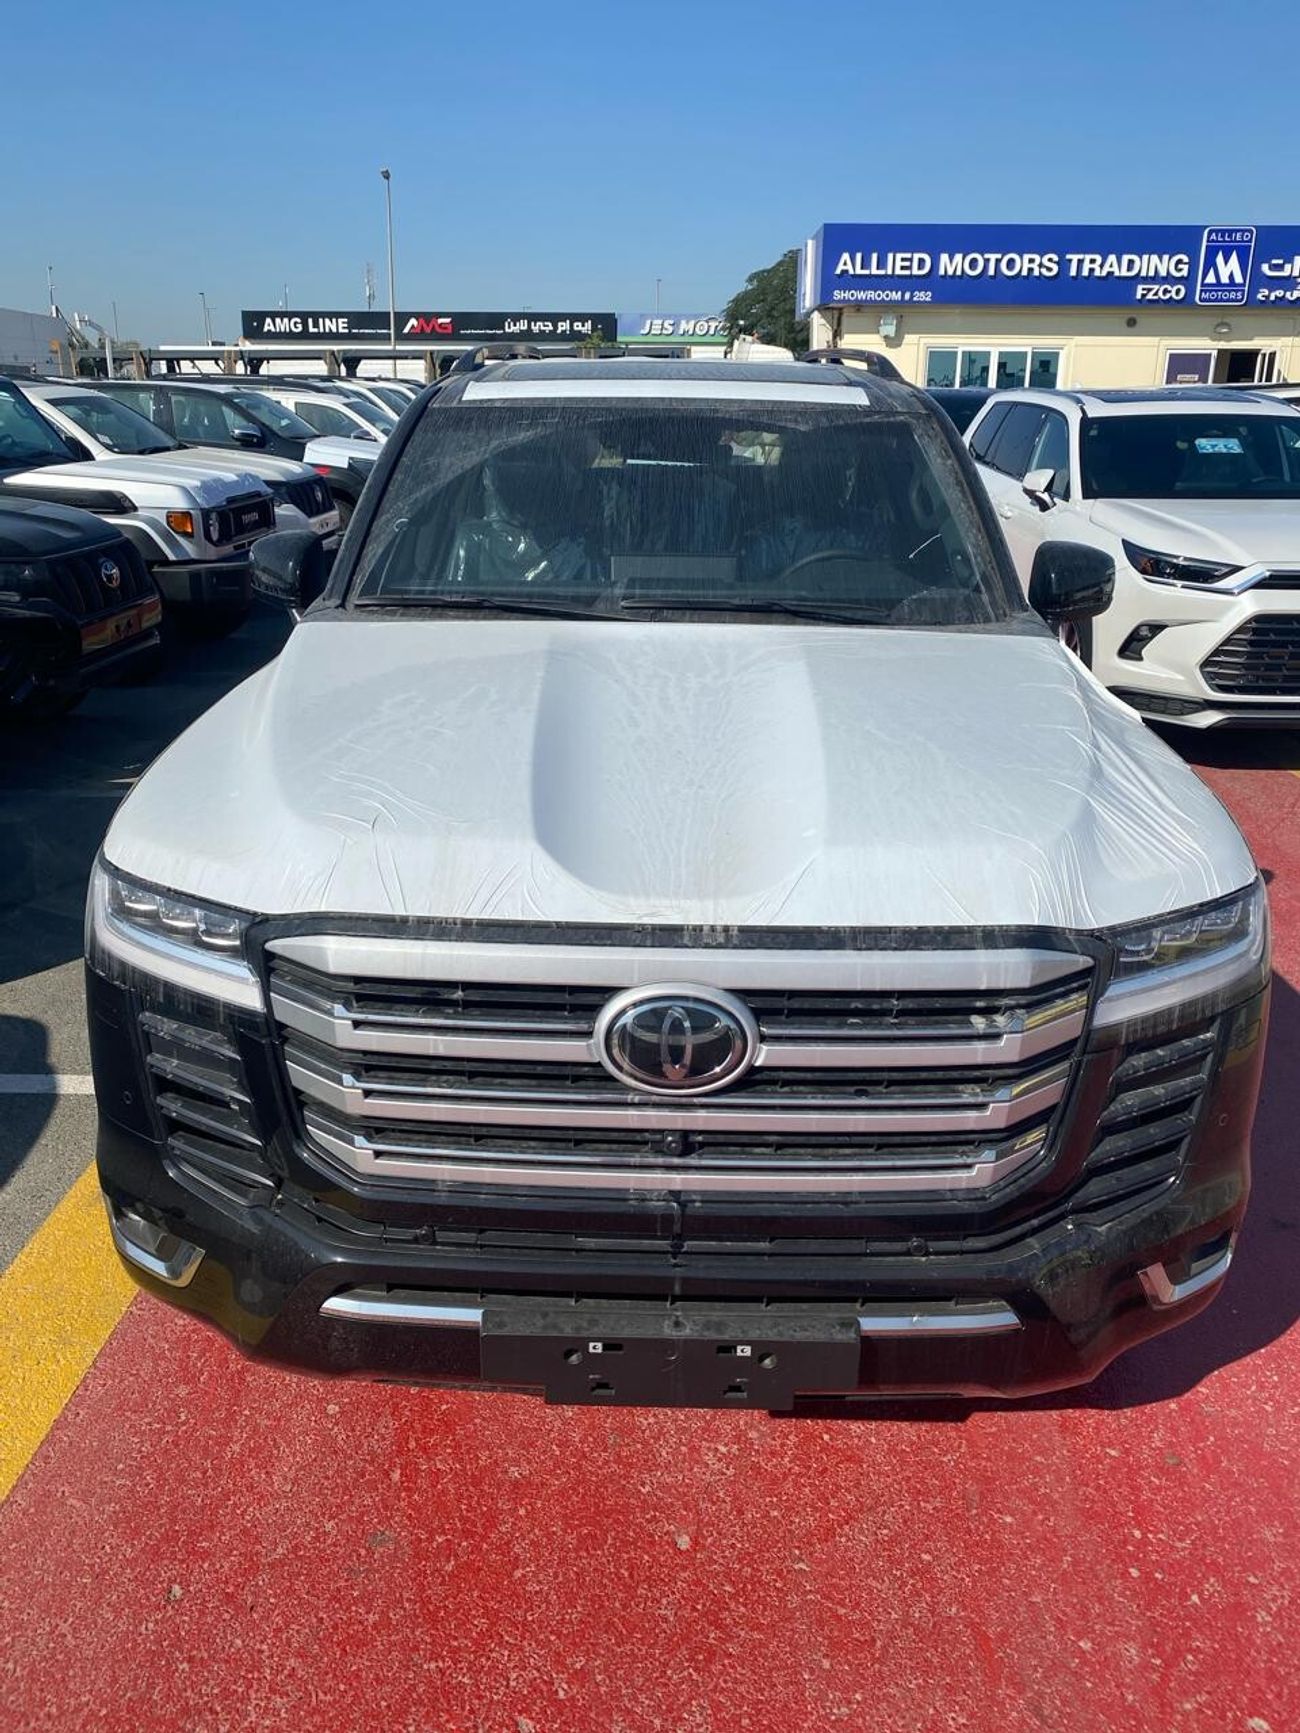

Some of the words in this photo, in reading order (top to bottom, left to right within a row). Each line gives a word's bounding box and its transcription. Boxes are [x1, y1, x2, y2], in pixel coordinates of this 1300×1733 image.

[1209, 232, 1251, 241] ALLIED
[834, 252, 932, 275] ALLIED
[938, 253, 1059, 277] MOTORS
[1065, 254, 1190, 277] TRADING
[833, 290, 901, 301] SHOWROOM
[904, 291, 911, 301] #
[913, 291, 932, 302] 252
[1135, 284, 1186, 300] FZCO
[1201, 291, 1243, 300] MOTORS
[263, 317, 302, 333] AMG
[308, 318, 348, 333] LINE
[402, 317, 452, 334] AMG
[640, 319, 675, 336] JES
